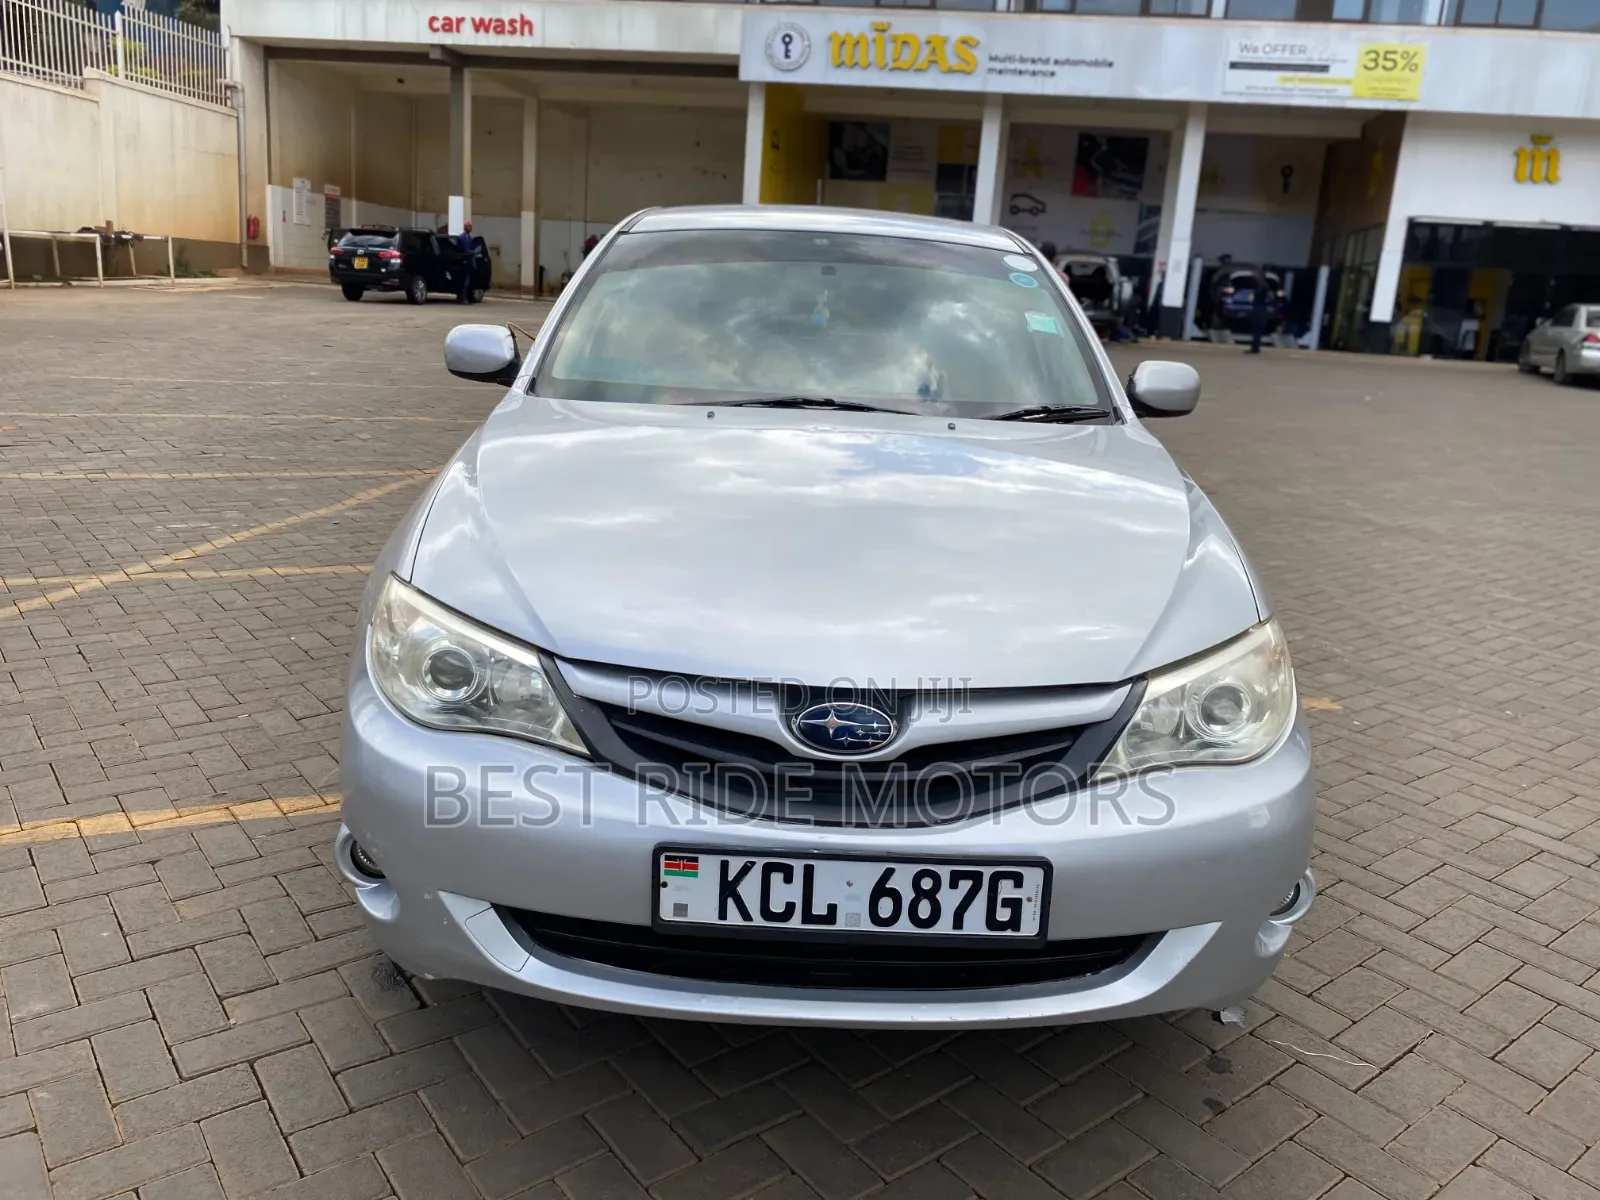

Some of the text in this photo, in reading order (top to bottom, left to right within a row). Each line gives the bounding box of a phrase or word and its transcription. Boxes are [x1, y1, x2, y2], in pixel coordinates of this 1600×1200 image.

[428, 13, 534, 37] car wash
[1238, 42, 1308, 56] We OFFER
[988, 52, 1114, 68] Multi-brand automobile
[1362, 49, 1419, 72] 35%
[987, 66, 1056, 78] maintenance
[717, 858, 838, 926] KCL
[867, 866, 1024, 932] 687G
